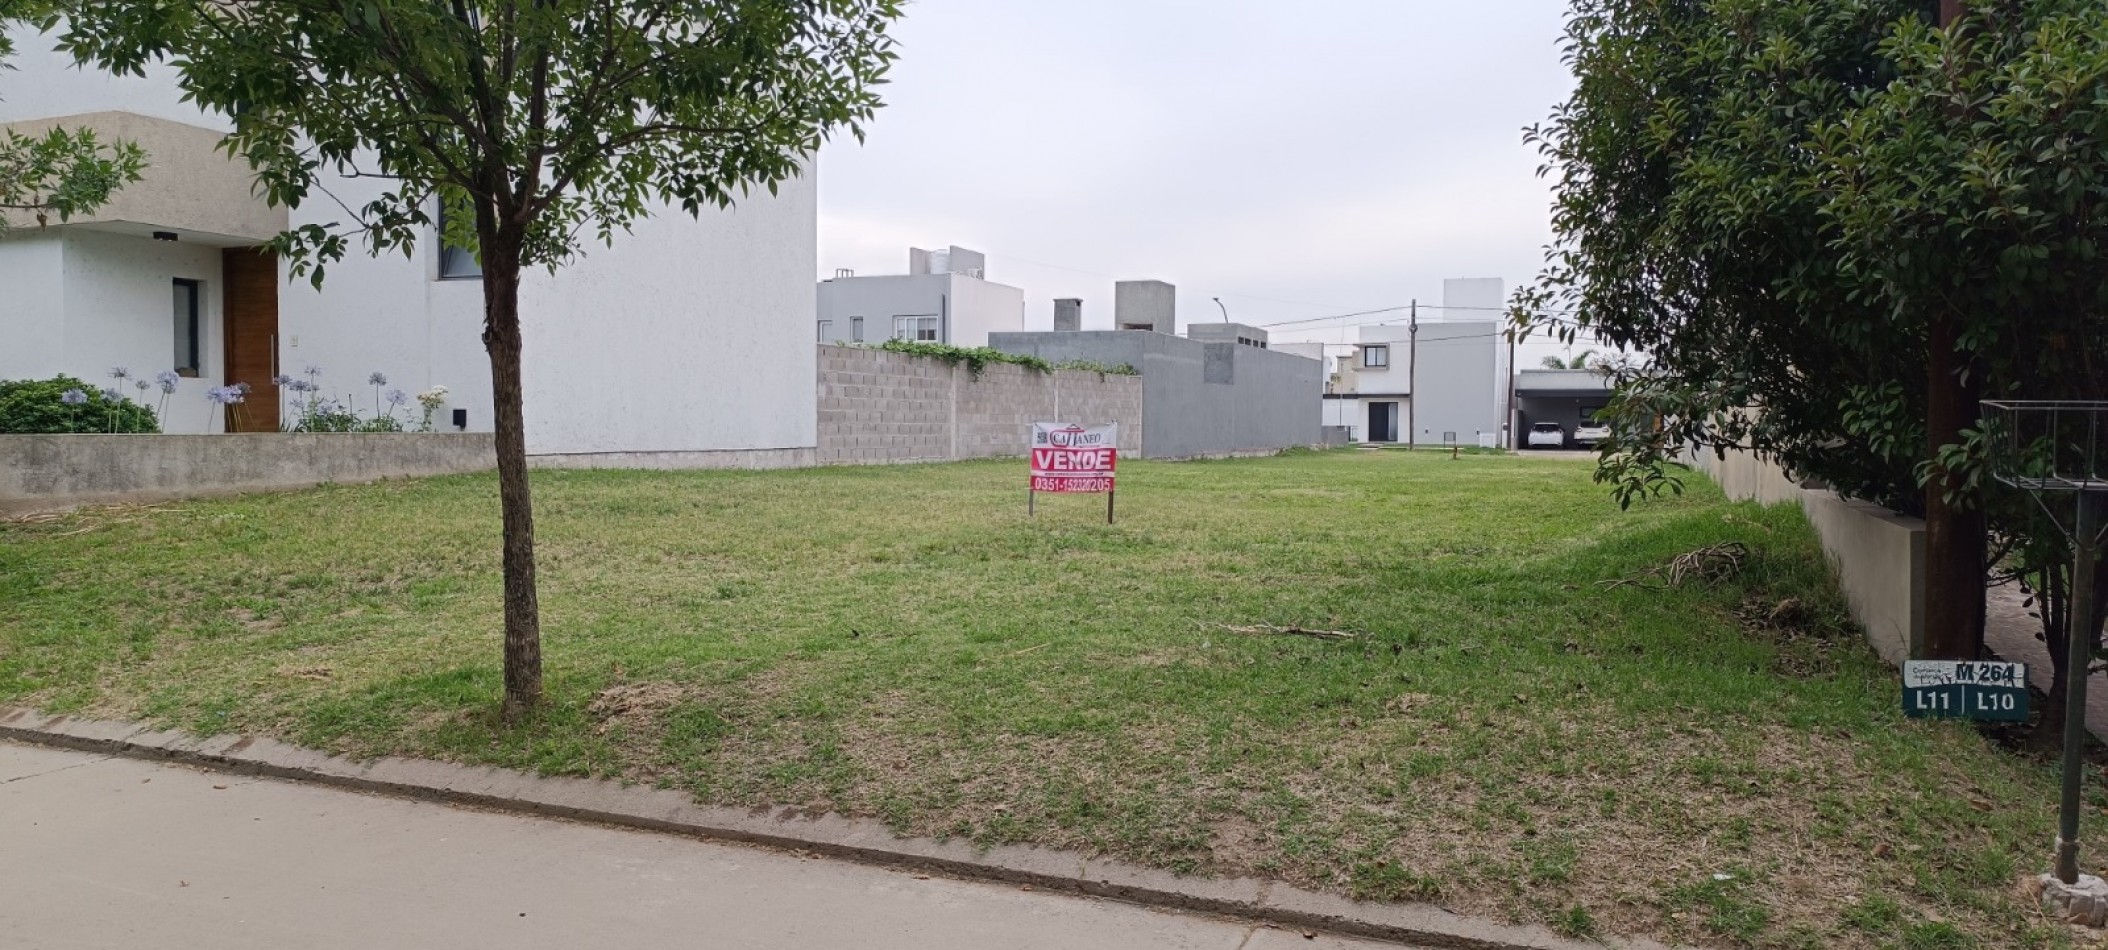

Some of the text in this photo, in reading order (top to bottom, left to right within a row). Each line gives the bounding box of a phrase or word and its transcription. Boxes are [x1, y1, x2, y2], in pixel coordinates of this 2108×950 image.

[1051, 430, 1101, 447] CATTANEO
[1035, 449, 1111, 470] VENDE
[1956, 662, 2015, 681] M 264
[1917, 690, 2014, 710] L11 L10
